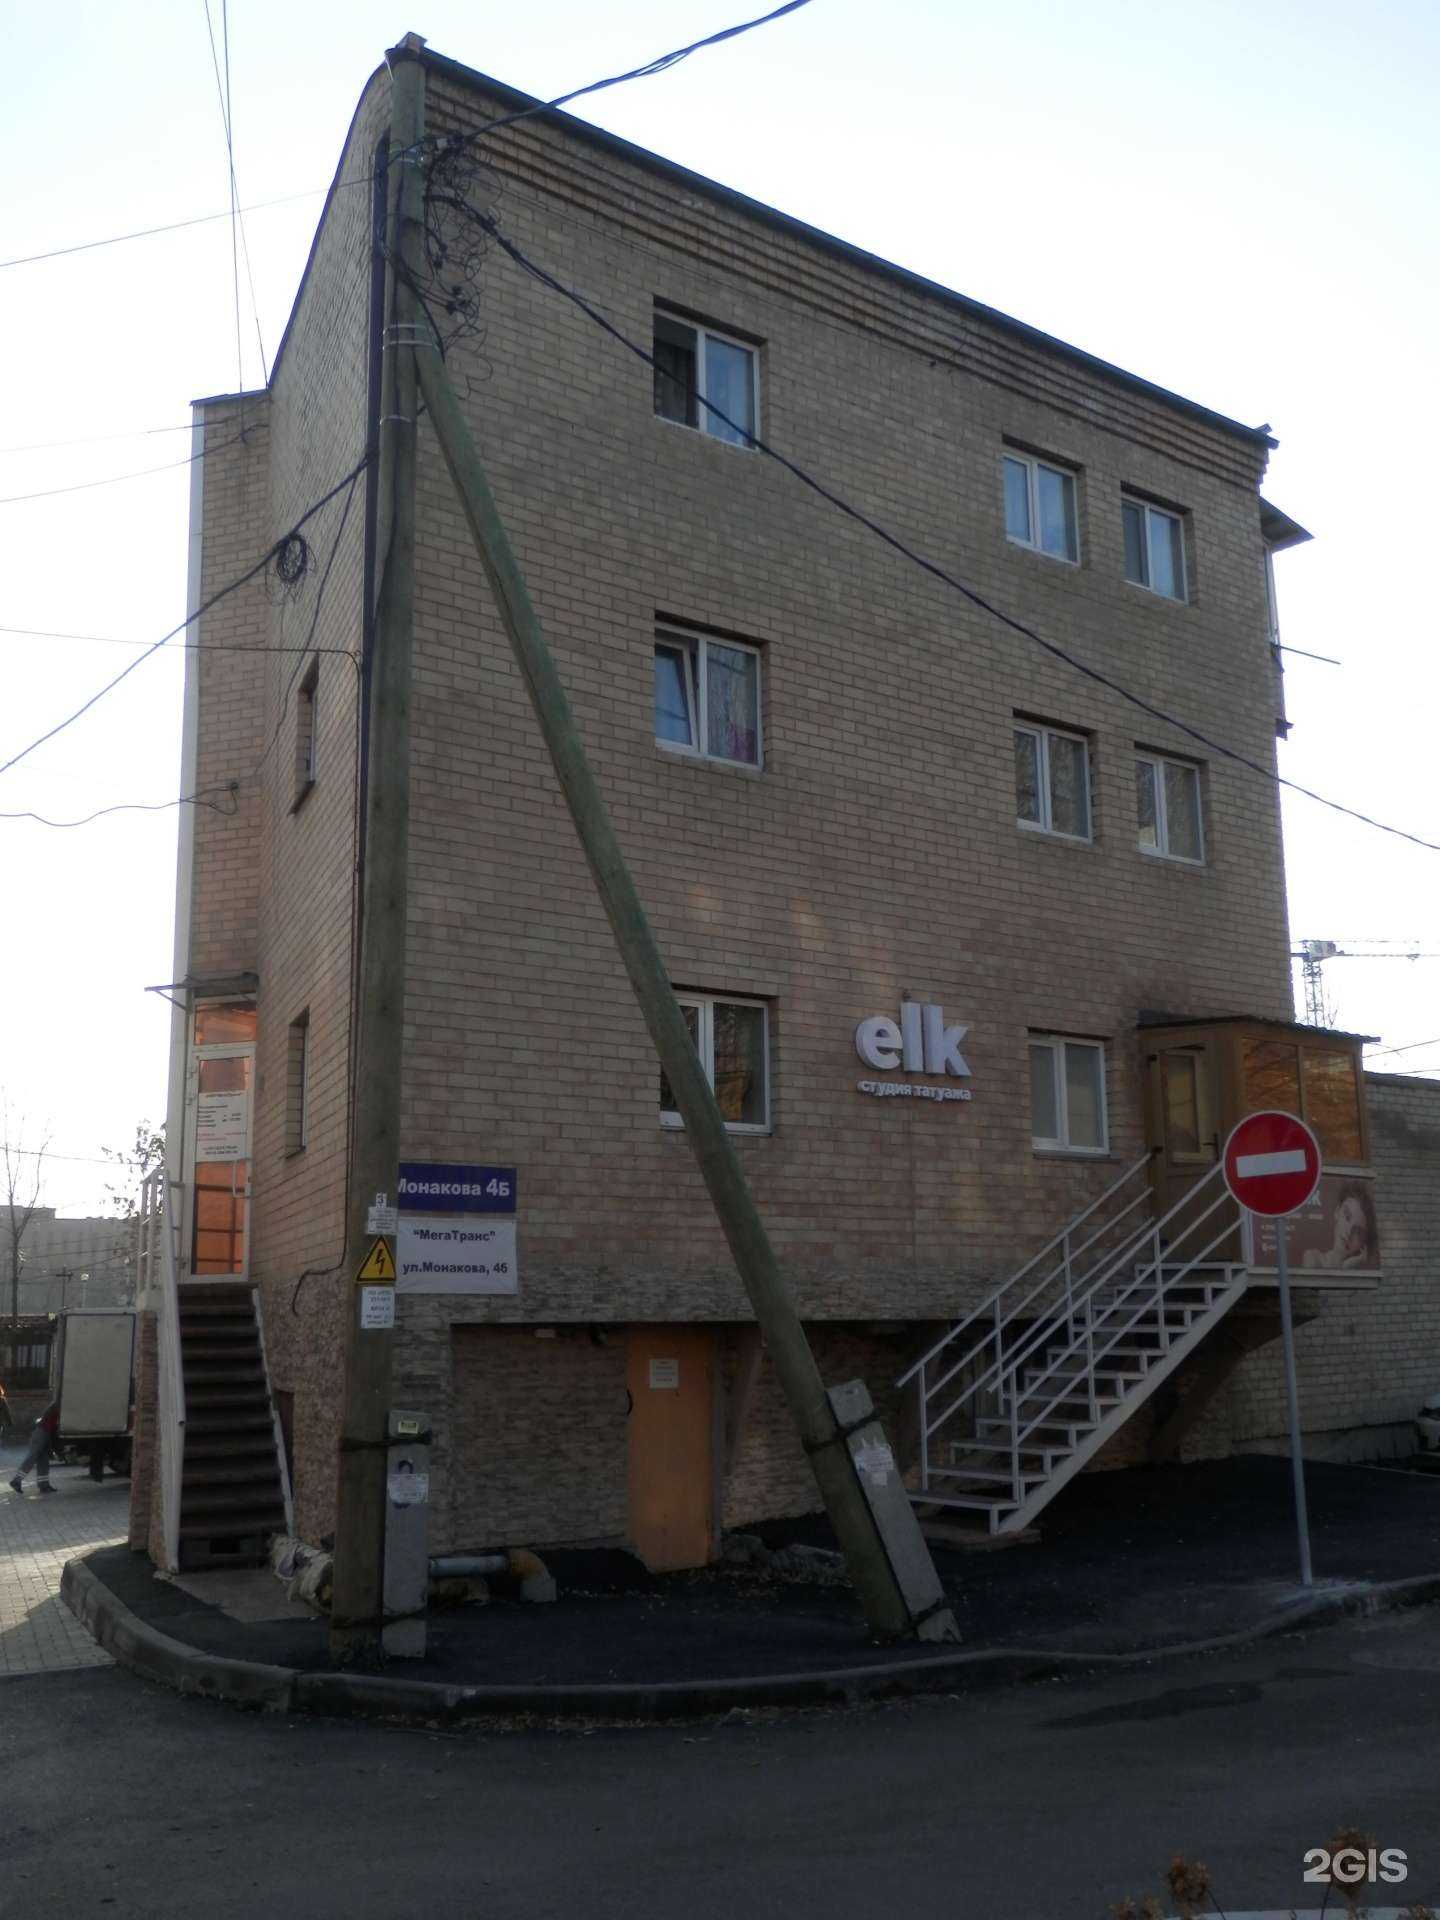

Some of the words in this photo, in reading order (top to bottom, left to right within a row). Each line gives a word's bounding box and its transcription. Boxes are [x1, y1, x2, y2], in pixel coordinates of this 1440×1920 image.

[855, 1002, 972, 1077] elk
[857, 1080, 912, 1097] студия
[913, 1085, 972, 1101] татуажа
[486, 1178, 510, 1197] 4Б
[402, 1261, 490, 1276] ул.Монакова,
